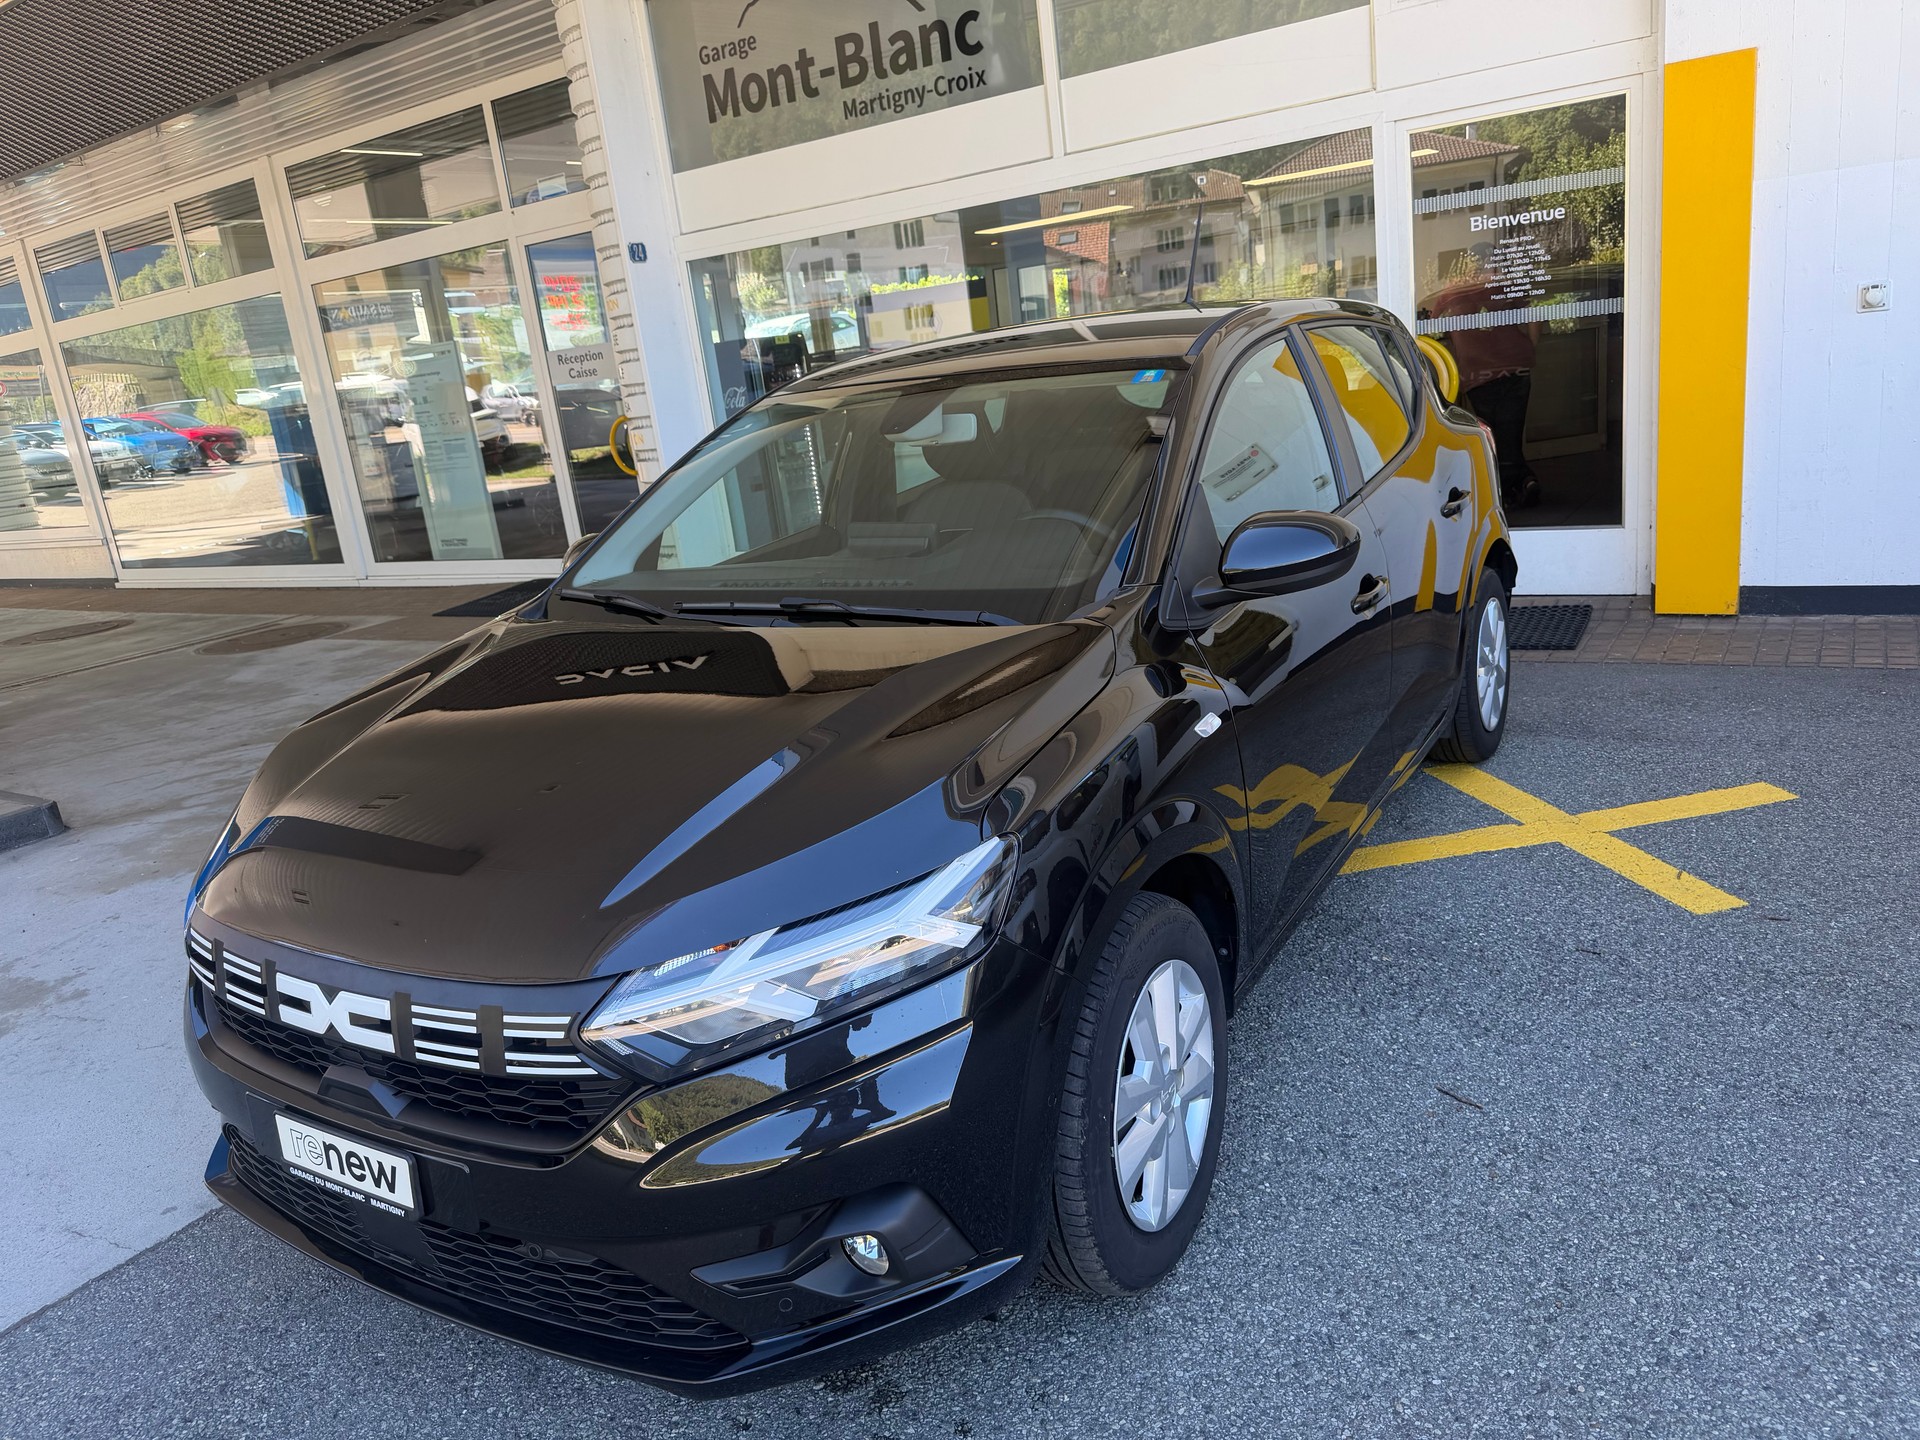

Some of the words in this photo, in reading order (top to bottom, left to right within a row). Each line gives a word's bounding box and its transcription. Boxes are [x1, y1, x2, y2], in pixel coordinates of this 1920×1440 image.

[698, 34, 757, 65] Garage
[702, 10, 984, 124] Mont-Blanc
[842, 66, 988, 120] Martigny-Croix
[1470, 206, 1566, 232] Bienvenue
[634, 244, 644, 262] 24
[557, 350, 604, 366] Réception
[568, 366, 598, 380] Caisse
[724, 386, 747, 410] Cola
[290, 1128, 396, 1194] renew
[289, 1166, 314, 1184] GARAGE
[315, 1176, 325, 1186] DU
[325, 1180, 366, 1202] MONT-BLANC
[370, 1198, 406, 1218] MARTIGNY
